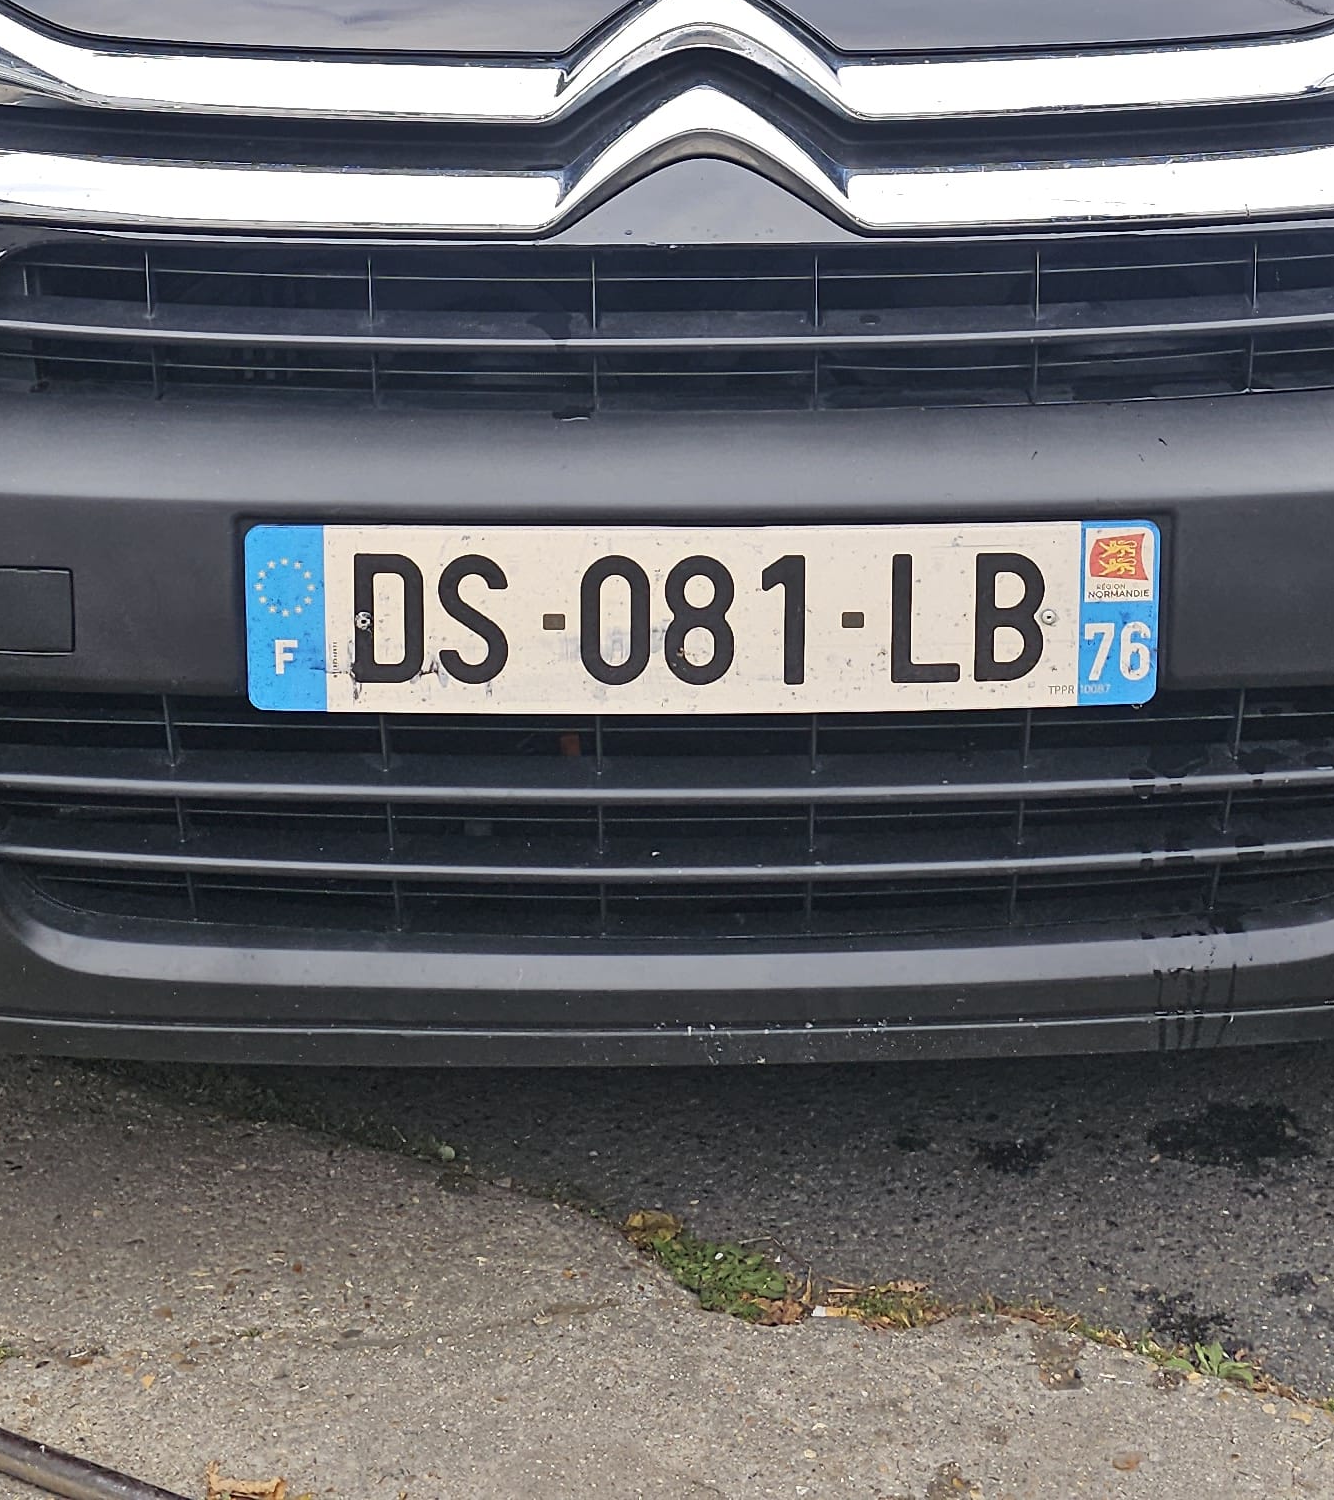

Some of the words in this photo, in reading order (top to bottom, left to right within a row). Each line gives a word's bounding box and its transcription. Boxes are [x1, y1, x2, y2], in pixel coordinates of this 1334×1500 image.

[1088, 589, 1150, 599] NORMANDIE
[275, 639, 298, 675] F
[1084, 621, 1151, 681] 76
